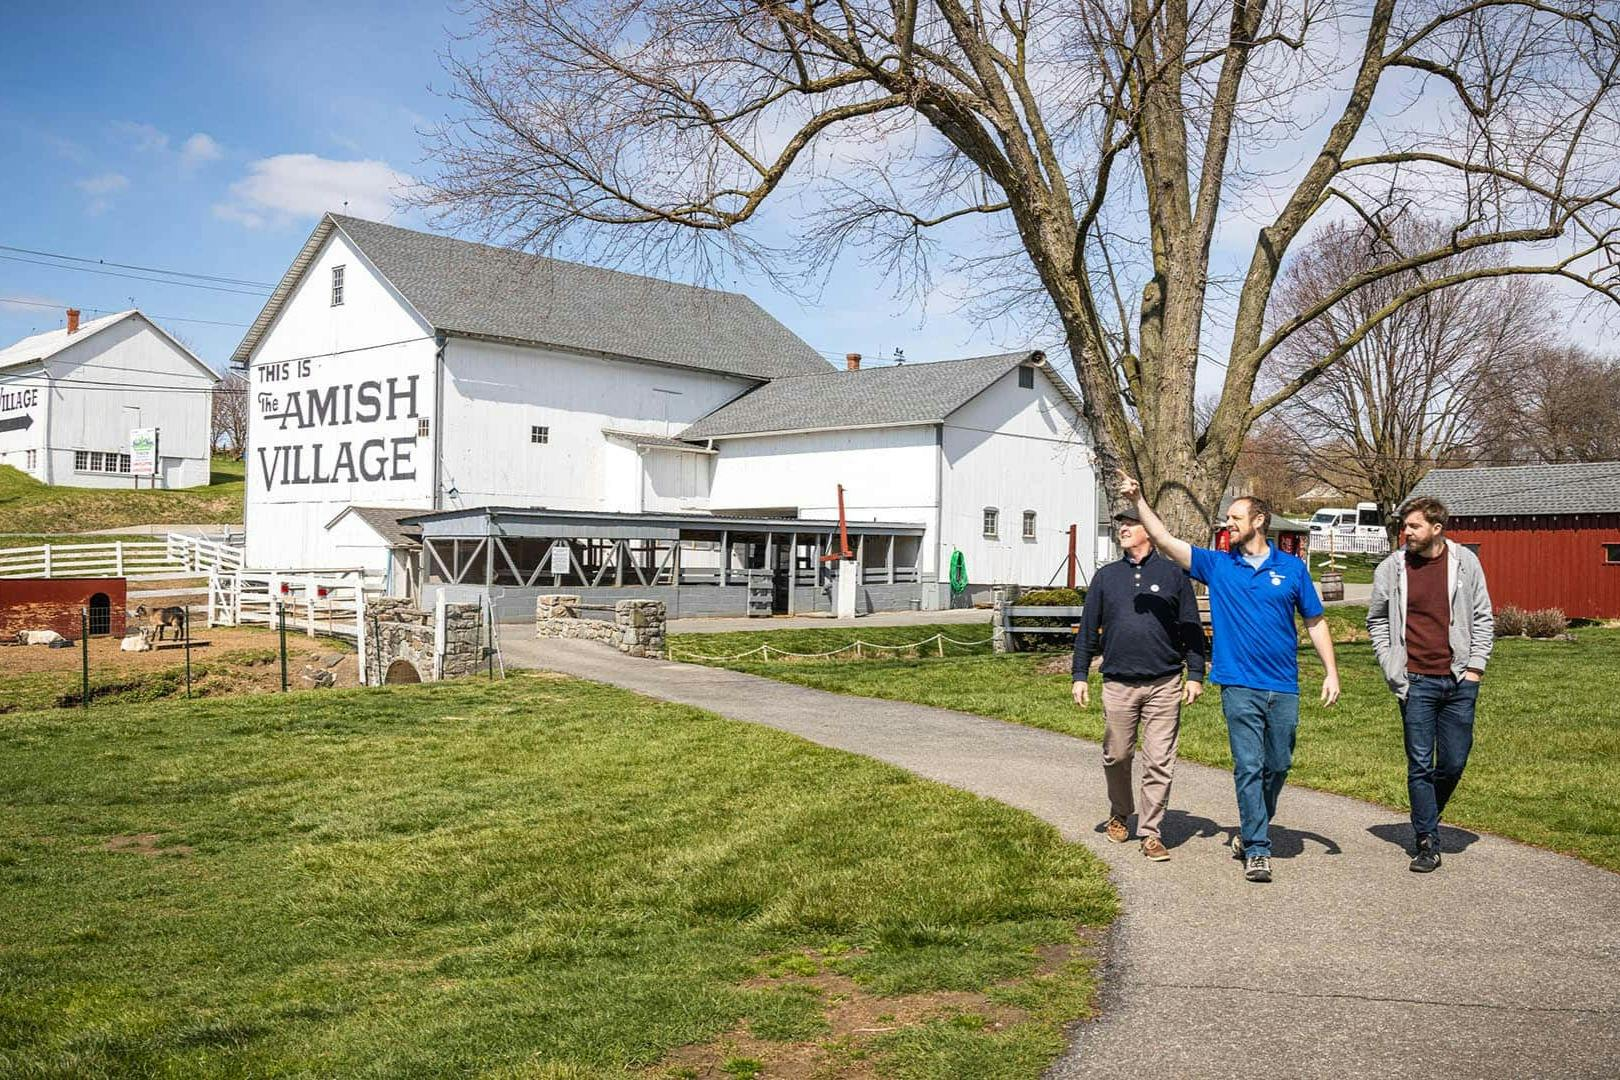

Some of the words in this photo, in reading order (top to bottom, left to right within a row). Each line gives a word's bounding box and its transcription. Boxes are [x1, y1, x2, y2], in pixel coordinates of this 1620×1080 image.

[258, 362, 290, 383] THIS
[297, 359, 311, 378] IS
[258, 391, 279, 413] The
[264, 374, 420, 430] AMISH
[257, 433, 418, 492] VILLAGE
